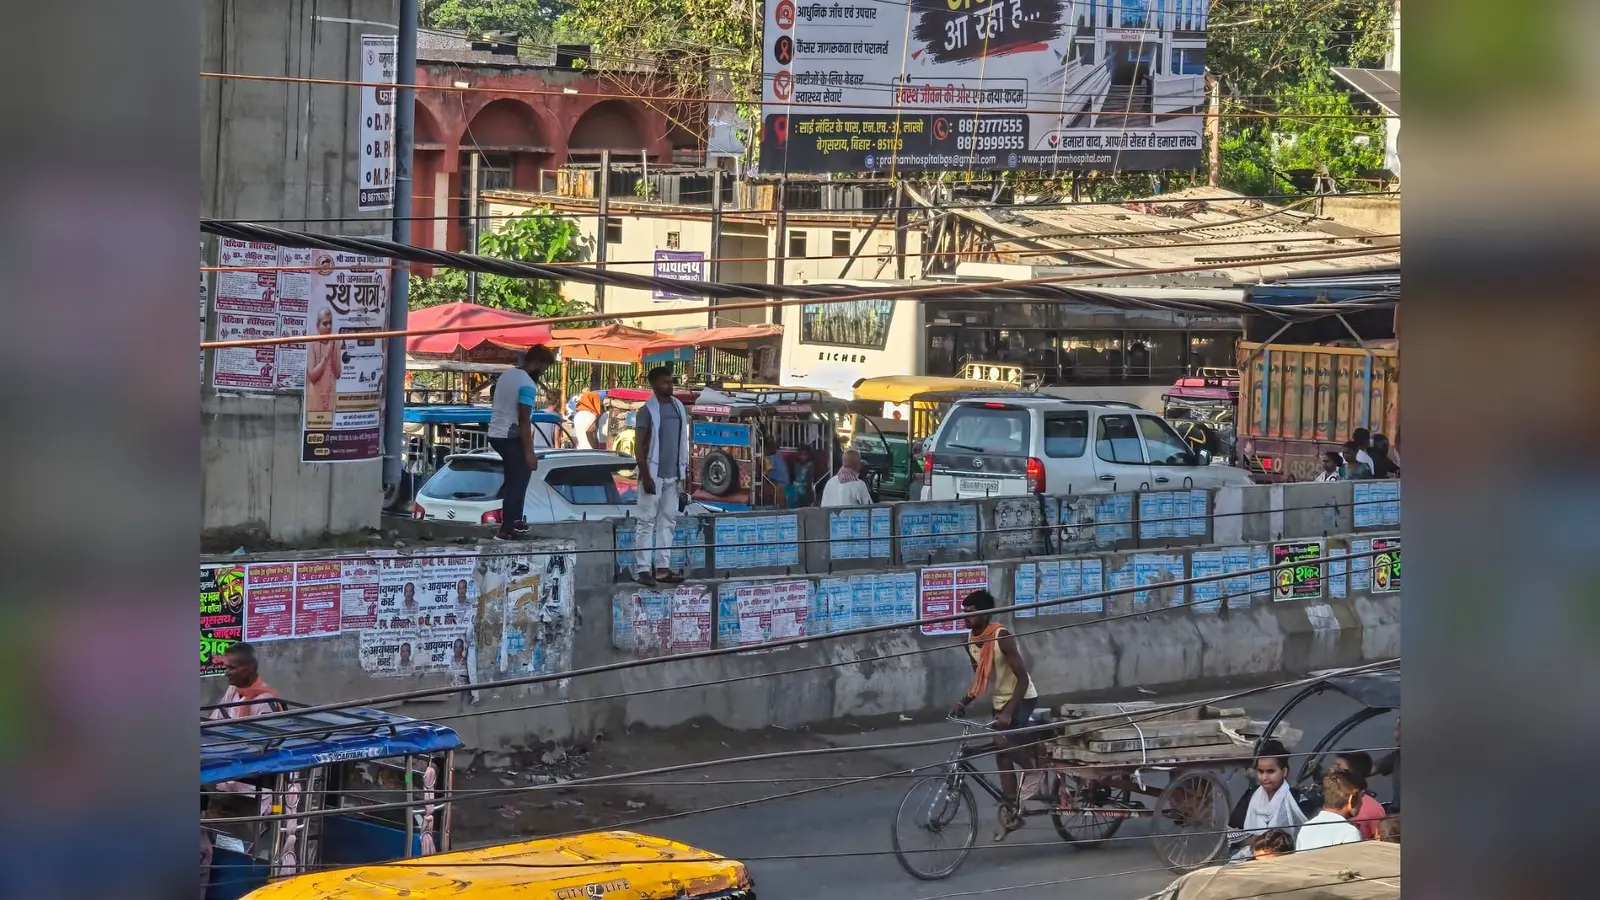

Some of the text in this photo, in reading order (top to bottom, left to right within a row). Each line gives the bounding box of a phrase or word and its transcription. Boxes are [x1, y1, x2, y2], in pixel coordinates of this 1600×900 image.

[797, 2, 877, 21] आधुनिक जाँच एवं उपचार
[944, 15, 969, 51] आ
[974, 2, 1005, 40] रहा
[816, 42, 852, 54] जागरूकता
[853, 41, 863, 54] एवं
[864, 41, 889, 55] परामर्श
[795, 71, 864, 85] मरीजों के लिए बेहतर
[795, 88, 843, 103] स्वास्थ्य सेवाएं
[895, 88, 918, 104] स्वस्थ
[920, 83, 942, 104] जीवन
[944, 83, 955, 104] की
[956, 84, 971, 104] ओर
[986, 88, 1002, 104] नया
[1004, 88, 1025, 104] कदम
[374, 113, 384, 131] D.
[815, 119, 834, 134] मंदिर
[836, 119, 844, 132] के
[845, 122, 861, 135] पास,
[959, 118, 1023, 133] 8873777555
[817, 137, 849, 155] बेगूसराय,
[851, 136, 871, 150] बिहार
[957, 137, 1025, 150] 8873999555
[1062, 133, 1198, 149] हमारा वादा, आपकी सेहत ही हमारा लक्ष्य
[374, 141, 383, 158] B.
[880, 154, 996, 167] prahamhospitalbgs@gmail.com
[373, 168, 383, 185] M.
[657, 254, 701, 273] शौचालय
[325, 284, 352, 315] रथ
[353, 285, 381, 308] यात्रा
[222, 316, 244, 325] वेदिका
[819, 352, 866, 363] EICHER
[380, 585, 403, 597] युष्मान
[428, 581, 456, 594] आयुष्मान
[381, 597, 395, 606] कार्ड
[435, 594, 449, 603] कार्ड
[214, 628, 240, 640] जादूगर
[370, 645, 399, 656] आयुष्मान
[423, 641, 453, 654] आयुष्मान
[377, 657, 391, 666] कार्ड
[431, 653, 444, 662] कार्ड
[557, 888, 585, 900] CITY
[605, 880, 630, 892] LIFE
